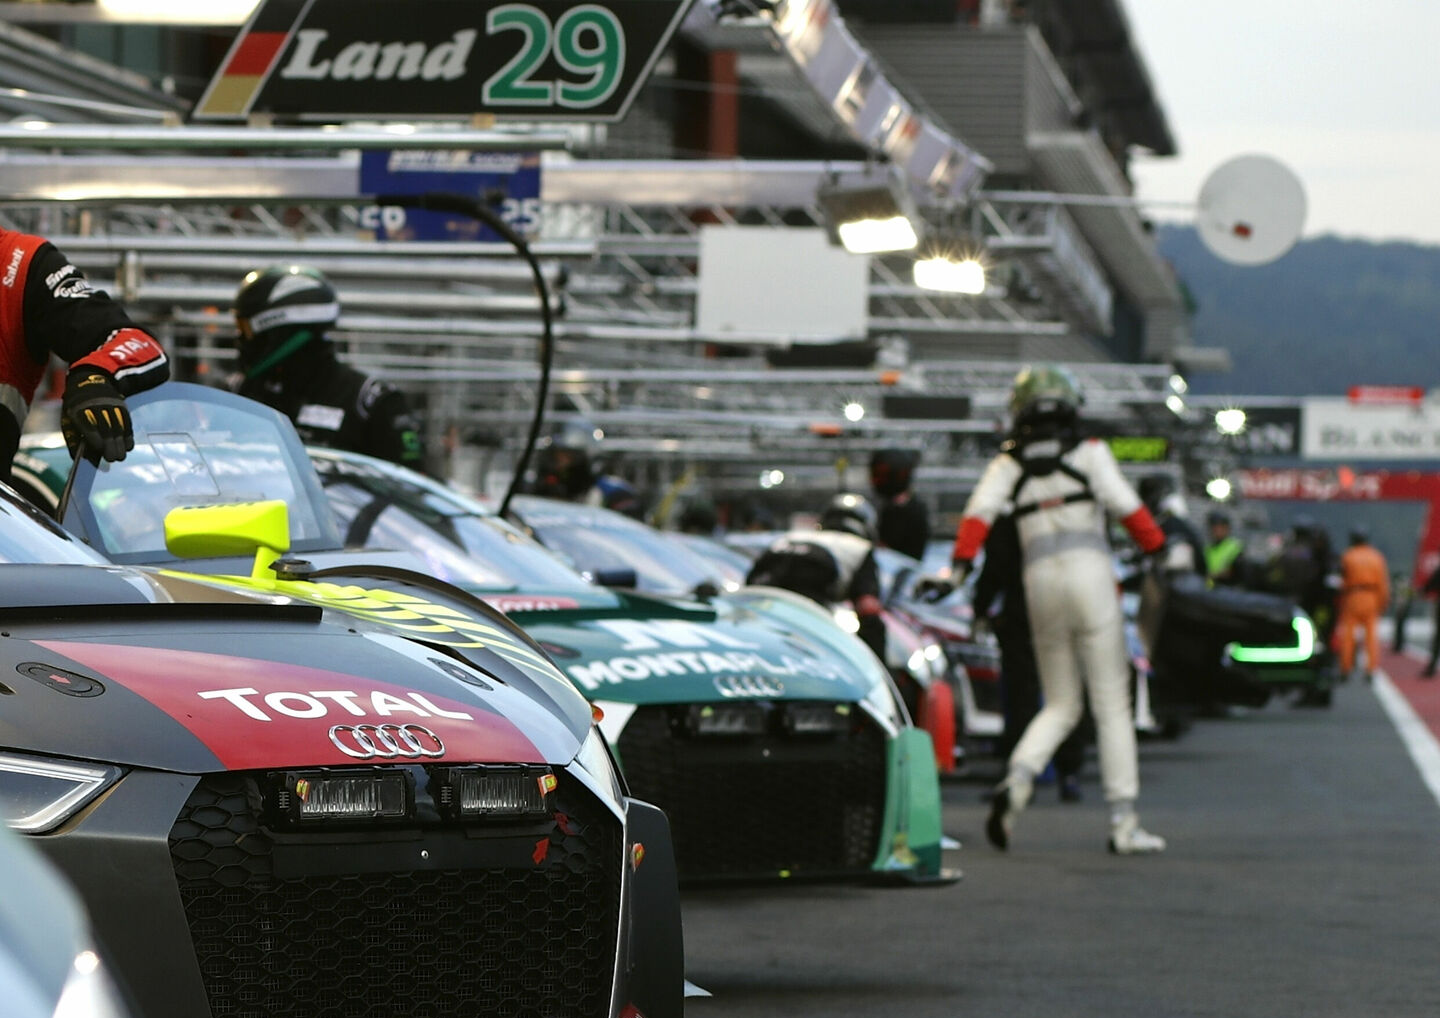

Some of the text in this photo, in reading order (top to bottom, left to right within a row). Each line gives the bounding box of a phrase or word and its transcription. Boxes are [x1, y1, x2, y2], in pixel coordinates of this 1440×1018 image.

[280, 27, 478, 81] Land
[482, 3, 626, 108] 29
[567, 650, 856, 690] MONTAPLAST
[197, 686, 473, 723] TOTAL
